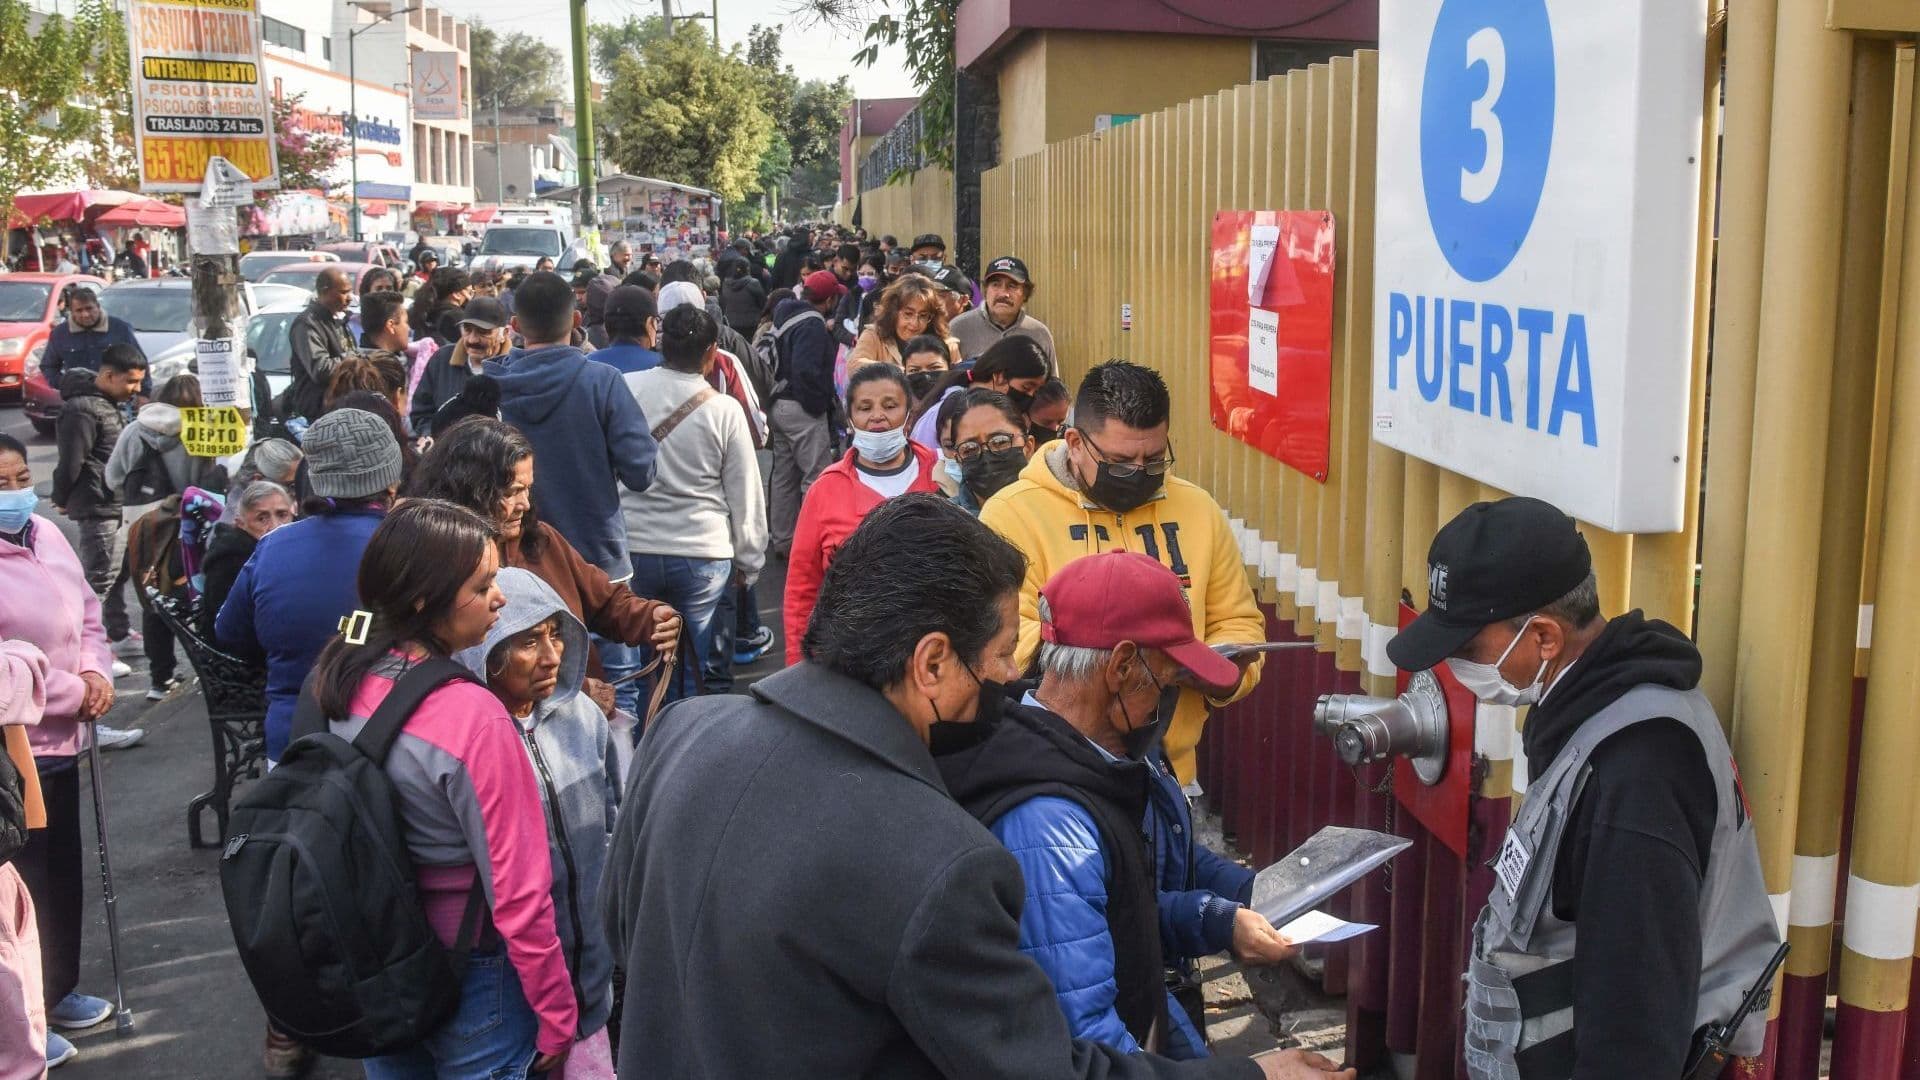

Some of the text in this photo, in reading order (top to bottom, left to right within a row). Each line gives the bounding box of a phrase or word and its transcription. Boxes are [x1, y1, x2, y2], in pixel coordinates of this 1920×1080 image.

[139, 7, 253, 55] ESQUIZOFRENIA
[145, 58, 256, 83] INTERNAMIENTO
[149, 84, 256, 98] PSIQUIATRA
[150, 118, 261, 132] TRASLADOS 24 hrs.
[1460, 26, 1506, 204] 3
[144, 139, 171, 179] 55
[1388, 292, 1598, 448] PUERTA
[187, 427, 237, 443] DEPTO
